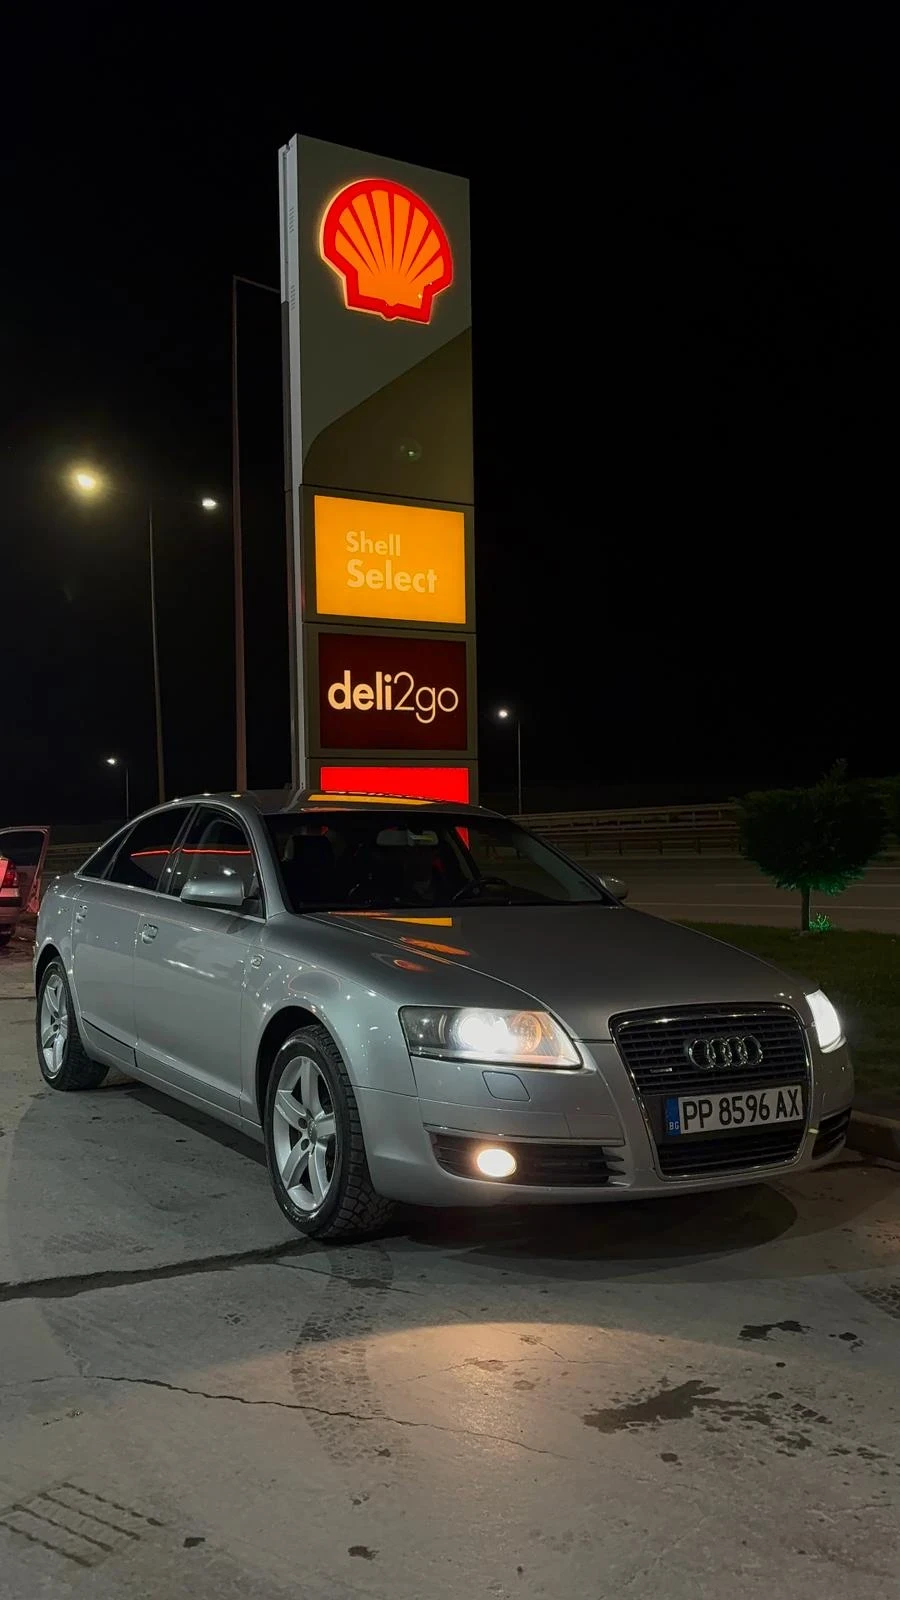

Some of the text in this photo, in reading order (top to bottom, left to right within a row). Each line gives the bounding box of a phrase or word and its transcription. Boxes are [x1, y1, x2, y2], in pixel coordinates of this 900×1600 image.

[345, 530, 401, 557] Shell
[346, 559, 438, 593] Select
[327, 669, 459, 724] deli2go
[669, 1121, 680, 1130] BG
[682, 1089, 800, 1130] PP 8596 AX
